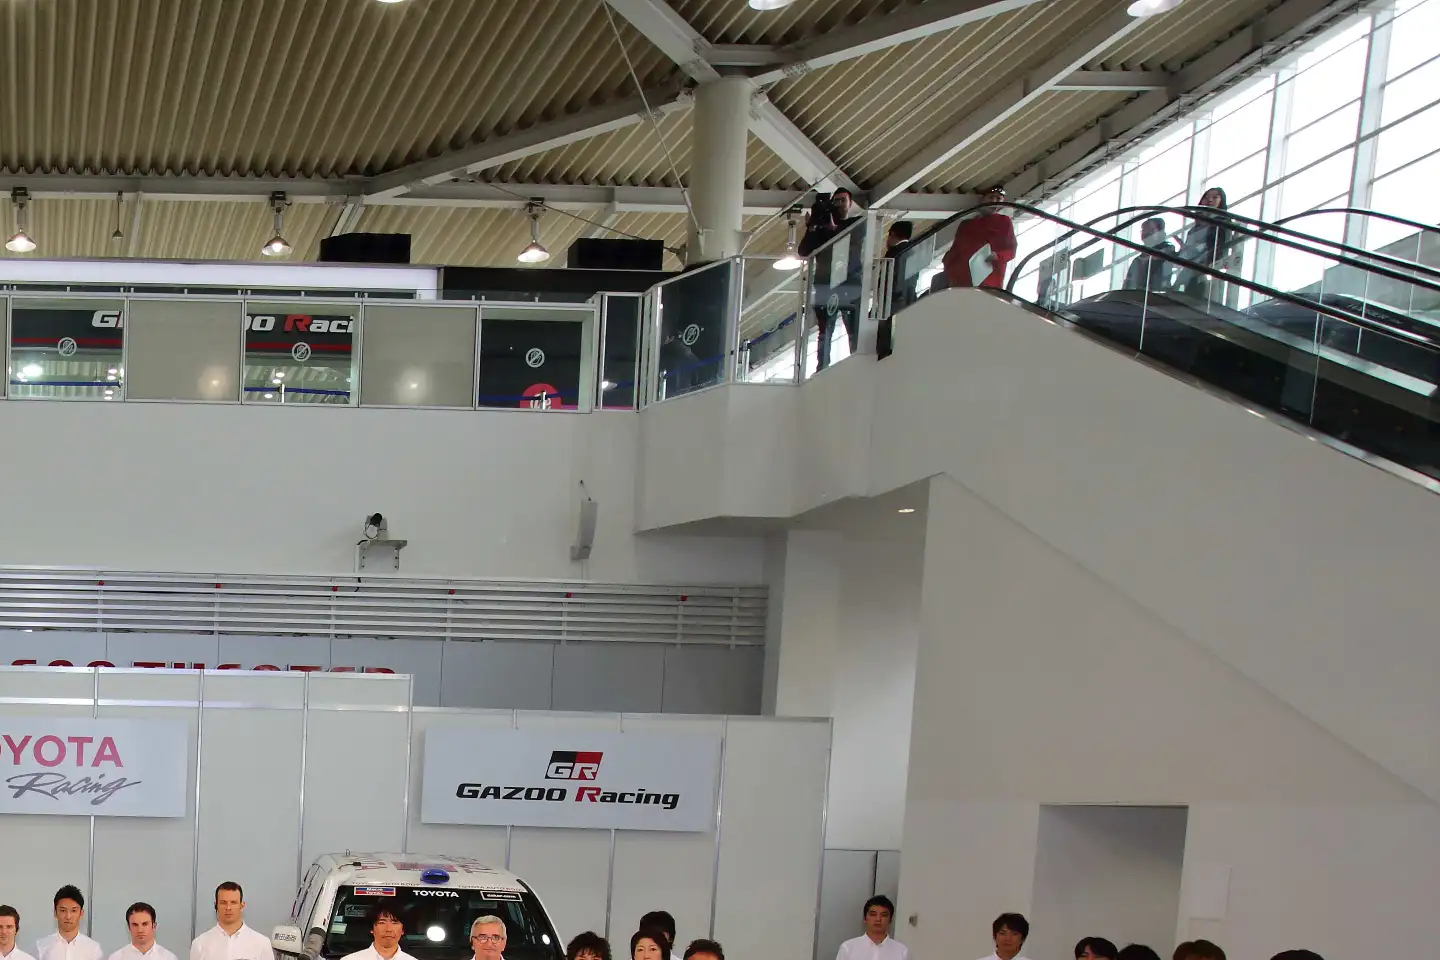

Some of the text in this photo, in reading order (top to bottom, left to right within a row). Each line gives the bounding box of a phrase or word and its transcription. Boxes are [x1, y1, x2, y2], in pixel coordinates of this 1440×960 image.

[284, 314, 353, 333] Raci
[547, 762, 600, 780] GR
[6, 772, 141, 805] Racing
[456, 783, 680, 810] GAZOO Racing
[413, 890, 460, 899] TOYOTA
